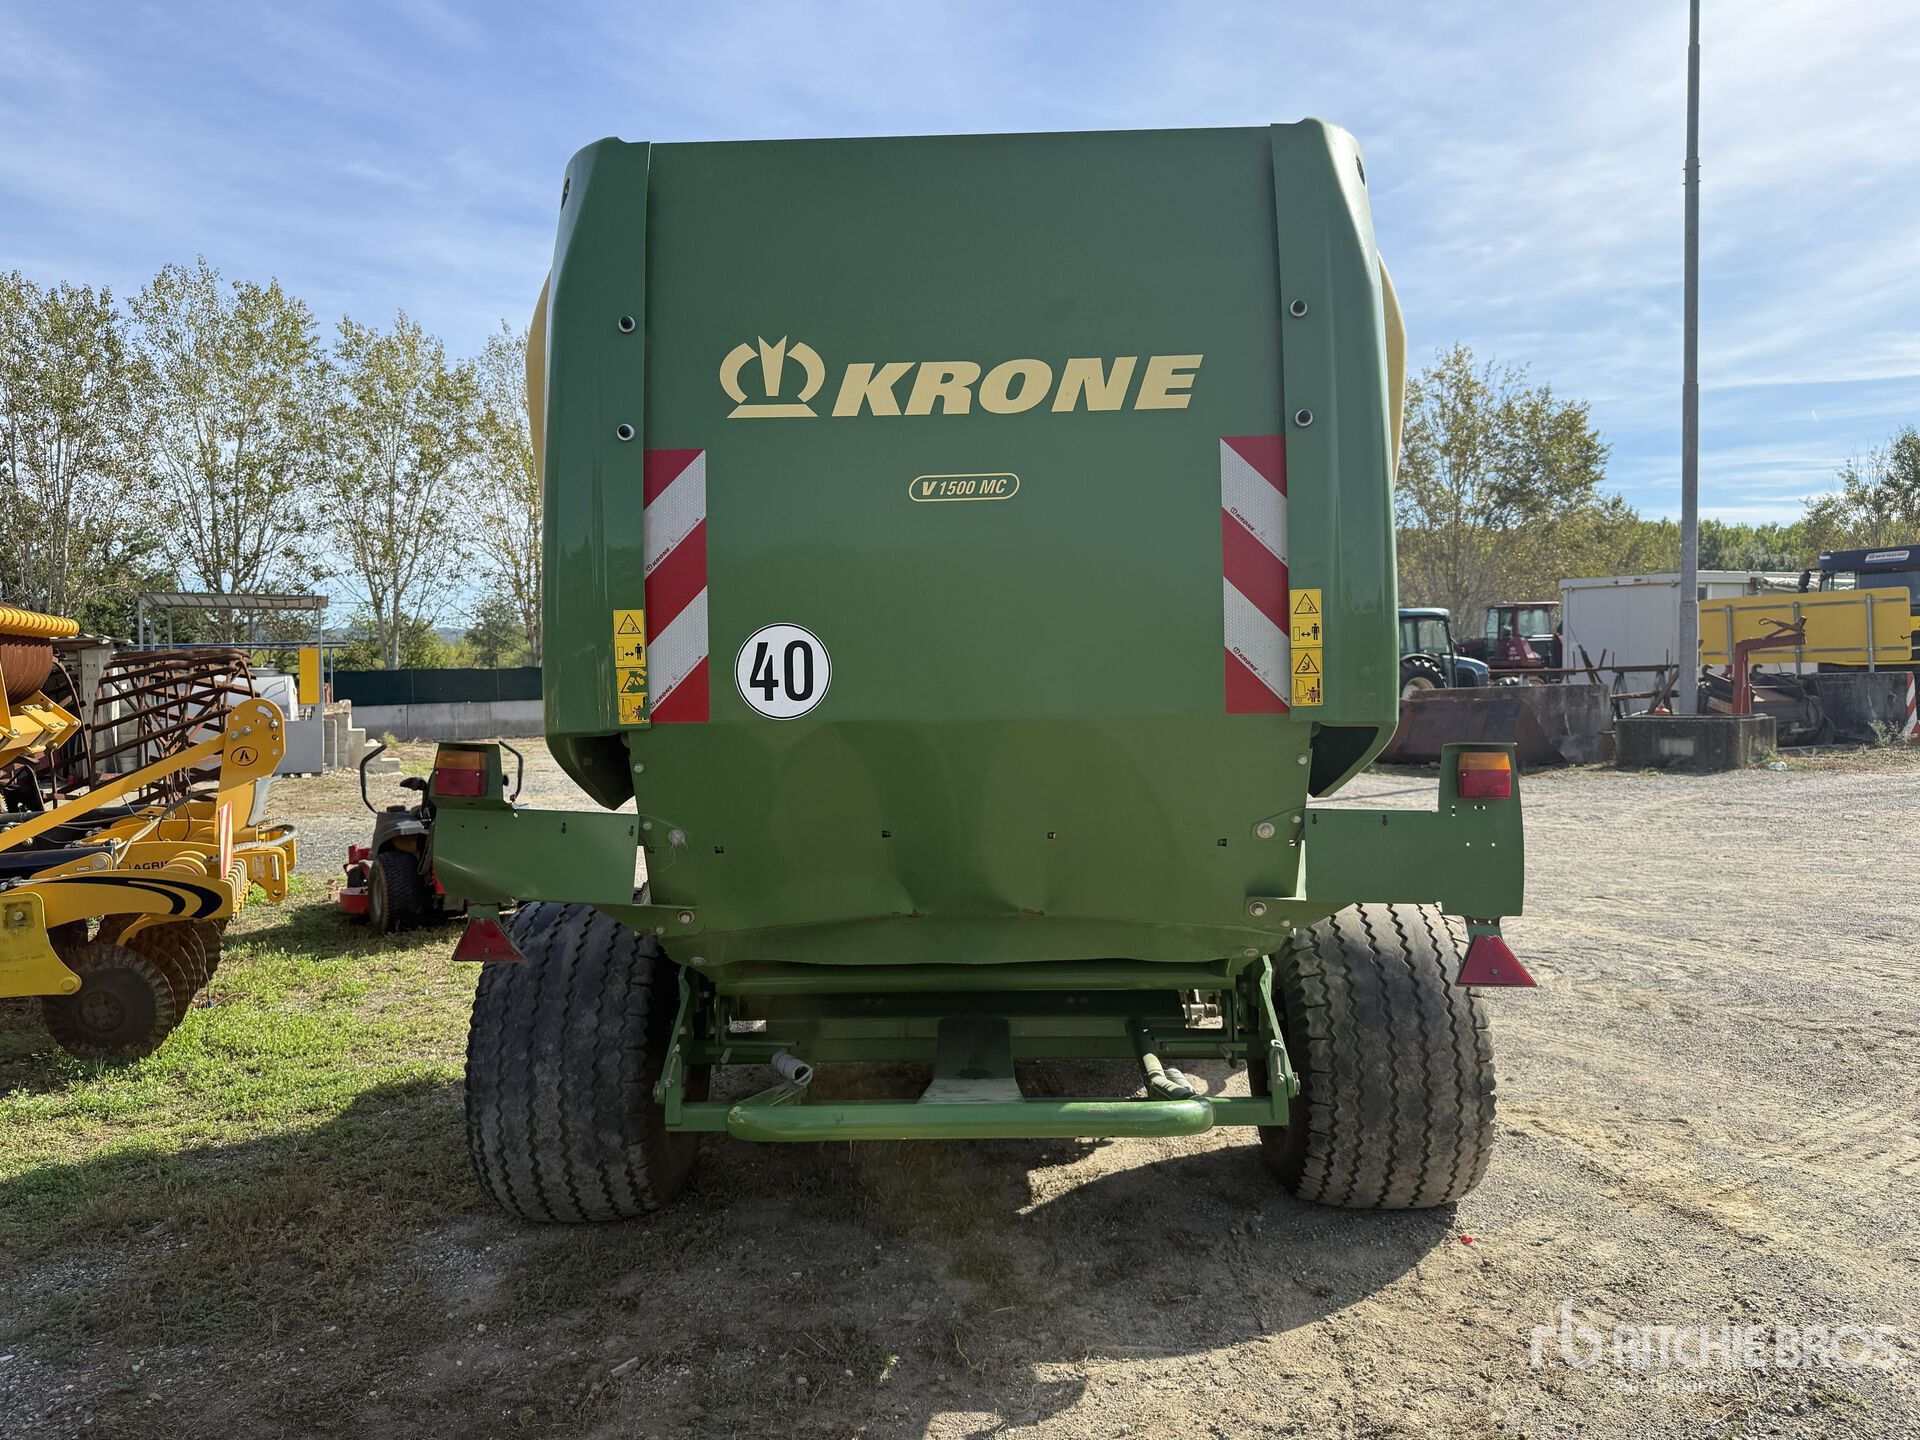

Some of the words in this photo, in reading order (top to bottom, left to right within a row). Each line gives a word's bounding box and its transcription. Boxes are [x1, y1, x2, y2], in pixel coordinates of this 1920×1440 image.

[831, 354, 1204, 417] KRONE
[922, 481, 937, 496] V
[939, 480, 977, 496] 1500
[979, 479, 1007, 494] MC
[1235, 513, 1256, 532] KRONE
[651, 546, 671, 567] KRONE
[749, 640, 814, 702] 40
[1238, 653, 1259, 672] KRONE
[655, 684, 673, 705] KRONE
